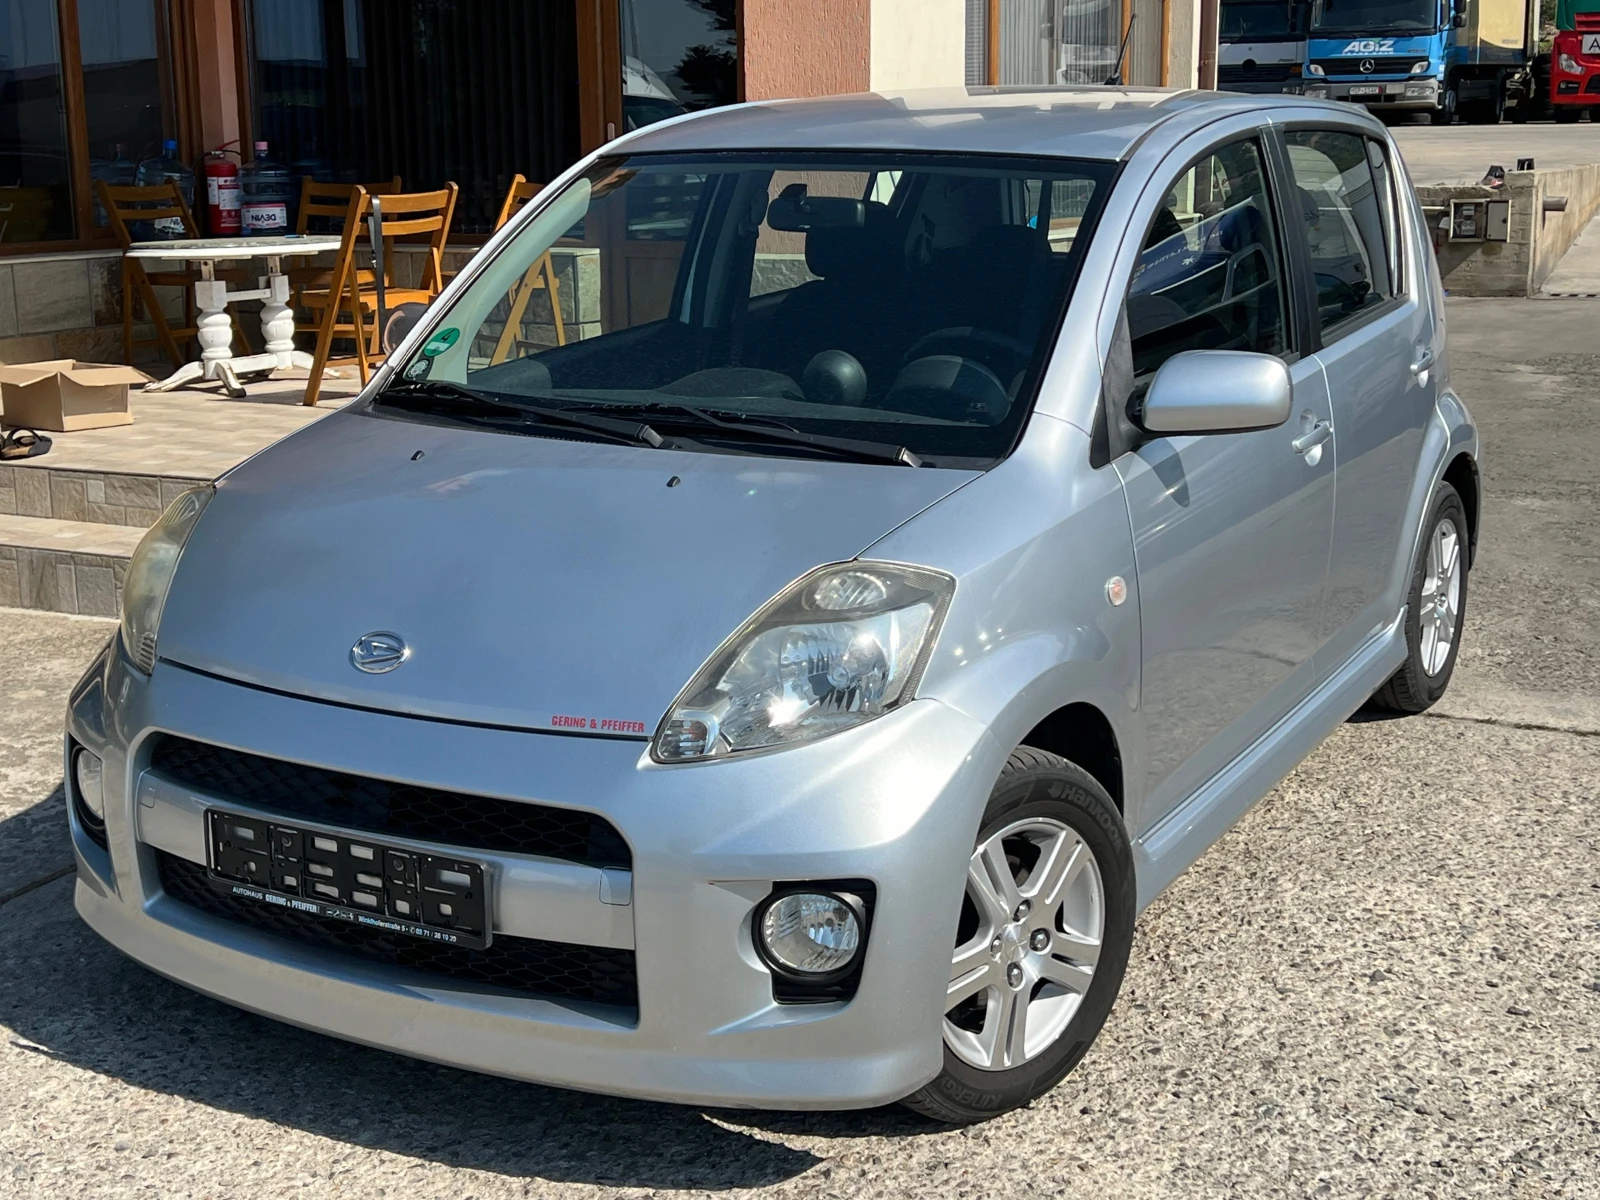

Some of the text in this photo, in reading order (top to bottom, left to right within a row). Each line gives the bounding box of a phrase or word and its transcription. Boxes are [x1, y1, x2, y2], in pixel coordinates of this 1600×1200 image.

[251, 213, 277, 222] DEVIN
[551, 715, 645, 733] GERING & PFEIFFER
[232, 886, 263, 900] AUTOHAUS
[265, 893, 287, 906] GERING
[291, 899, 317, 914] PFEIFFER
[415, 928, 423, 936] 03
